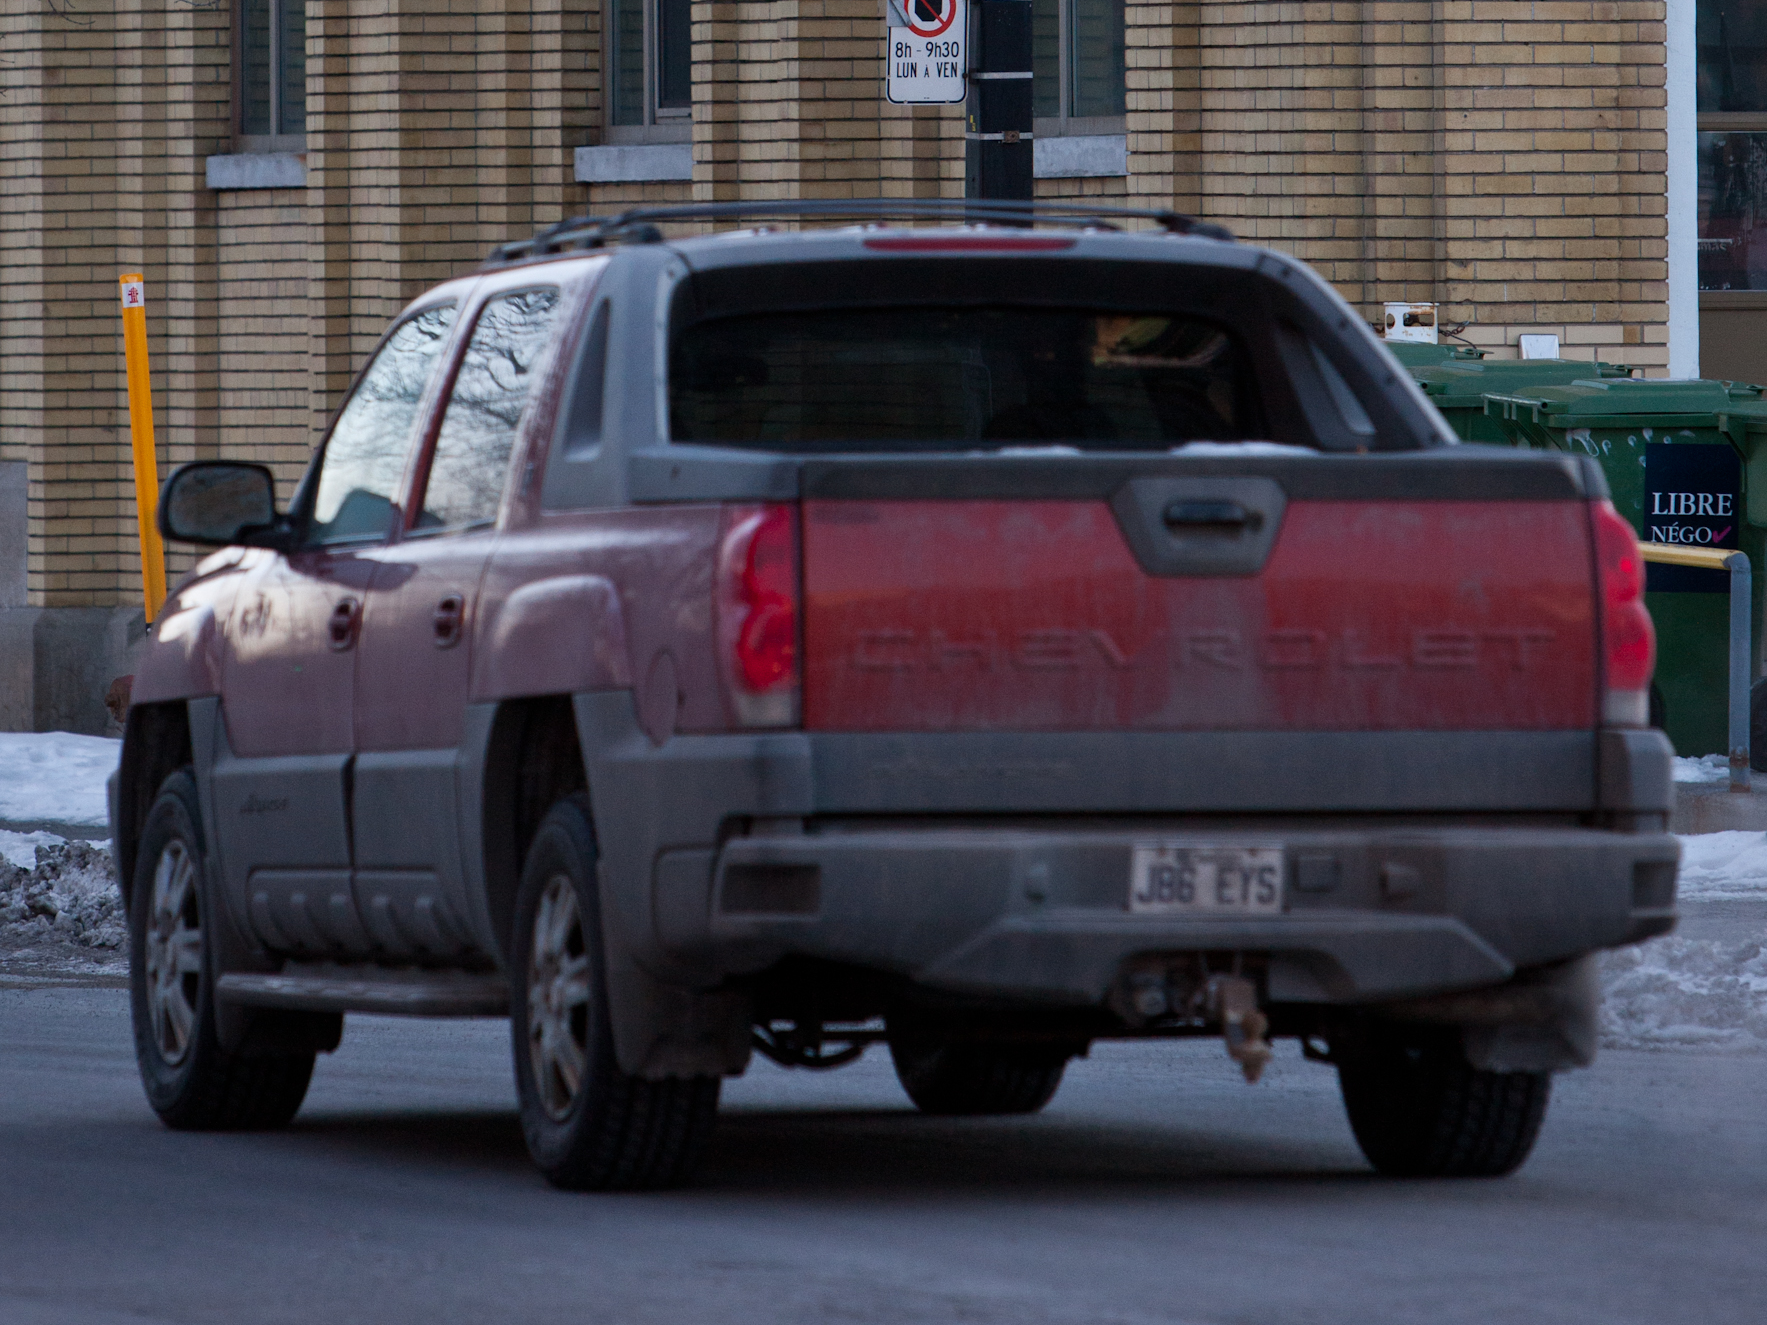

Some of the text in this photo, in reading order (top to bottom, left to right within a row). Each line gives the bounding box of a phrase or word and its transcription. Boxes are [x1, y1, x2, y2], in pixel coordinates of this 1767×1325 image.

[895, 41, 912, 58] 8h
[925, 42, 959, 58] 9h30
[896, 62, 917, 78] LUN
[936, 62, 957, 78] VEN
[1652, 492, 1732, 516] LIBRE
[1651, 521, 1713, 544] NÉGO
[846, 628, 1557, 675] CHEVROLET
[1216, 865, 1276, 904] EYS
